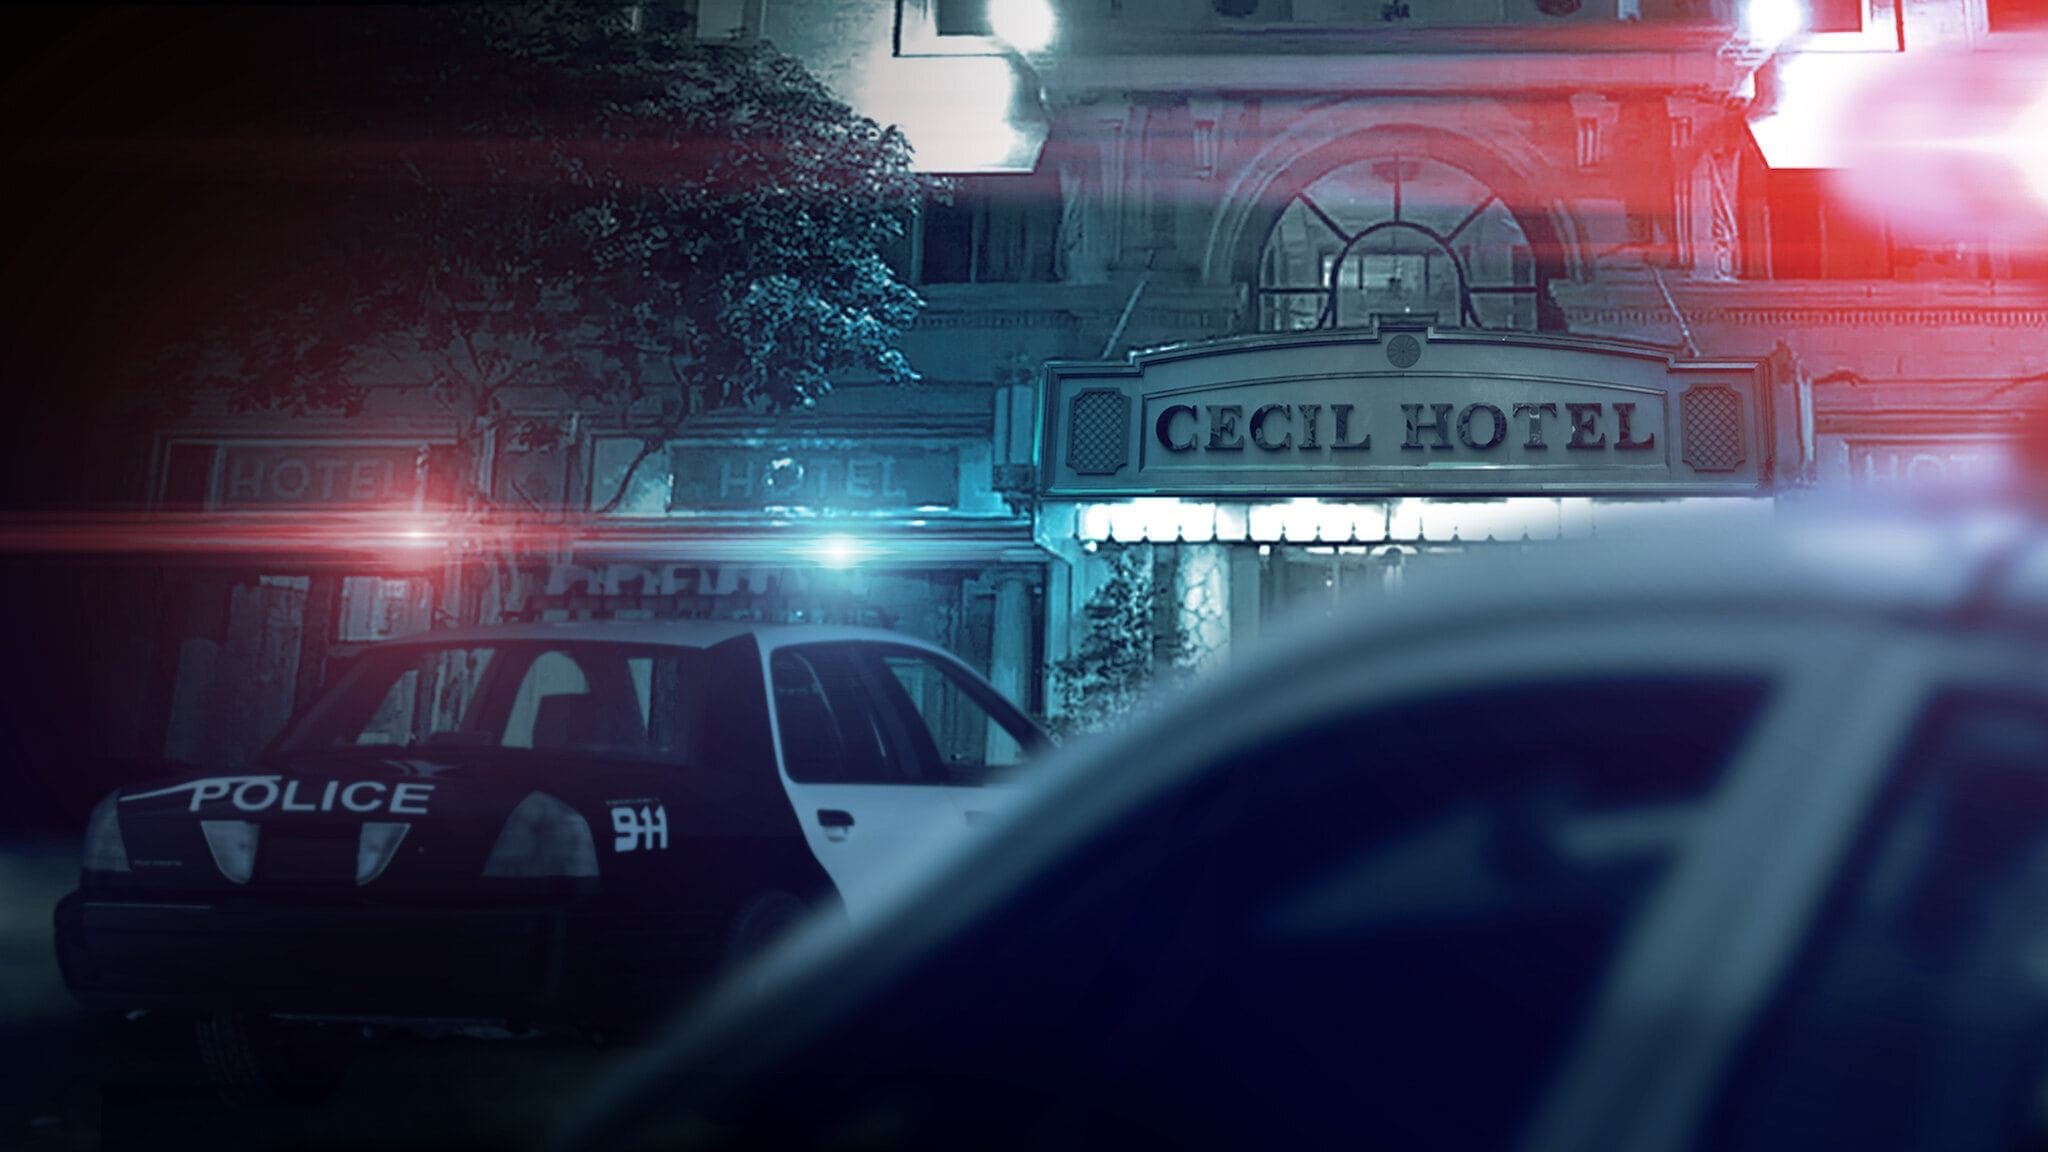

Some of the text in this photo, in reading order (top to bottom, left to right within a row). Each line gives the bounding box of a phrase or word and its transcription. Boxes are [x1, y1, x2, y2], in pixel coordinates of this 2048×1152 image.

[1155, 402, 1655, 452] CECIL HOTEL
[229, 457, 407, 500] HOTEL
[719, 455, 906, 499] HOTEL
[188, 776, 436, 814] POLICE
[610, 804, 669, 853] 911
